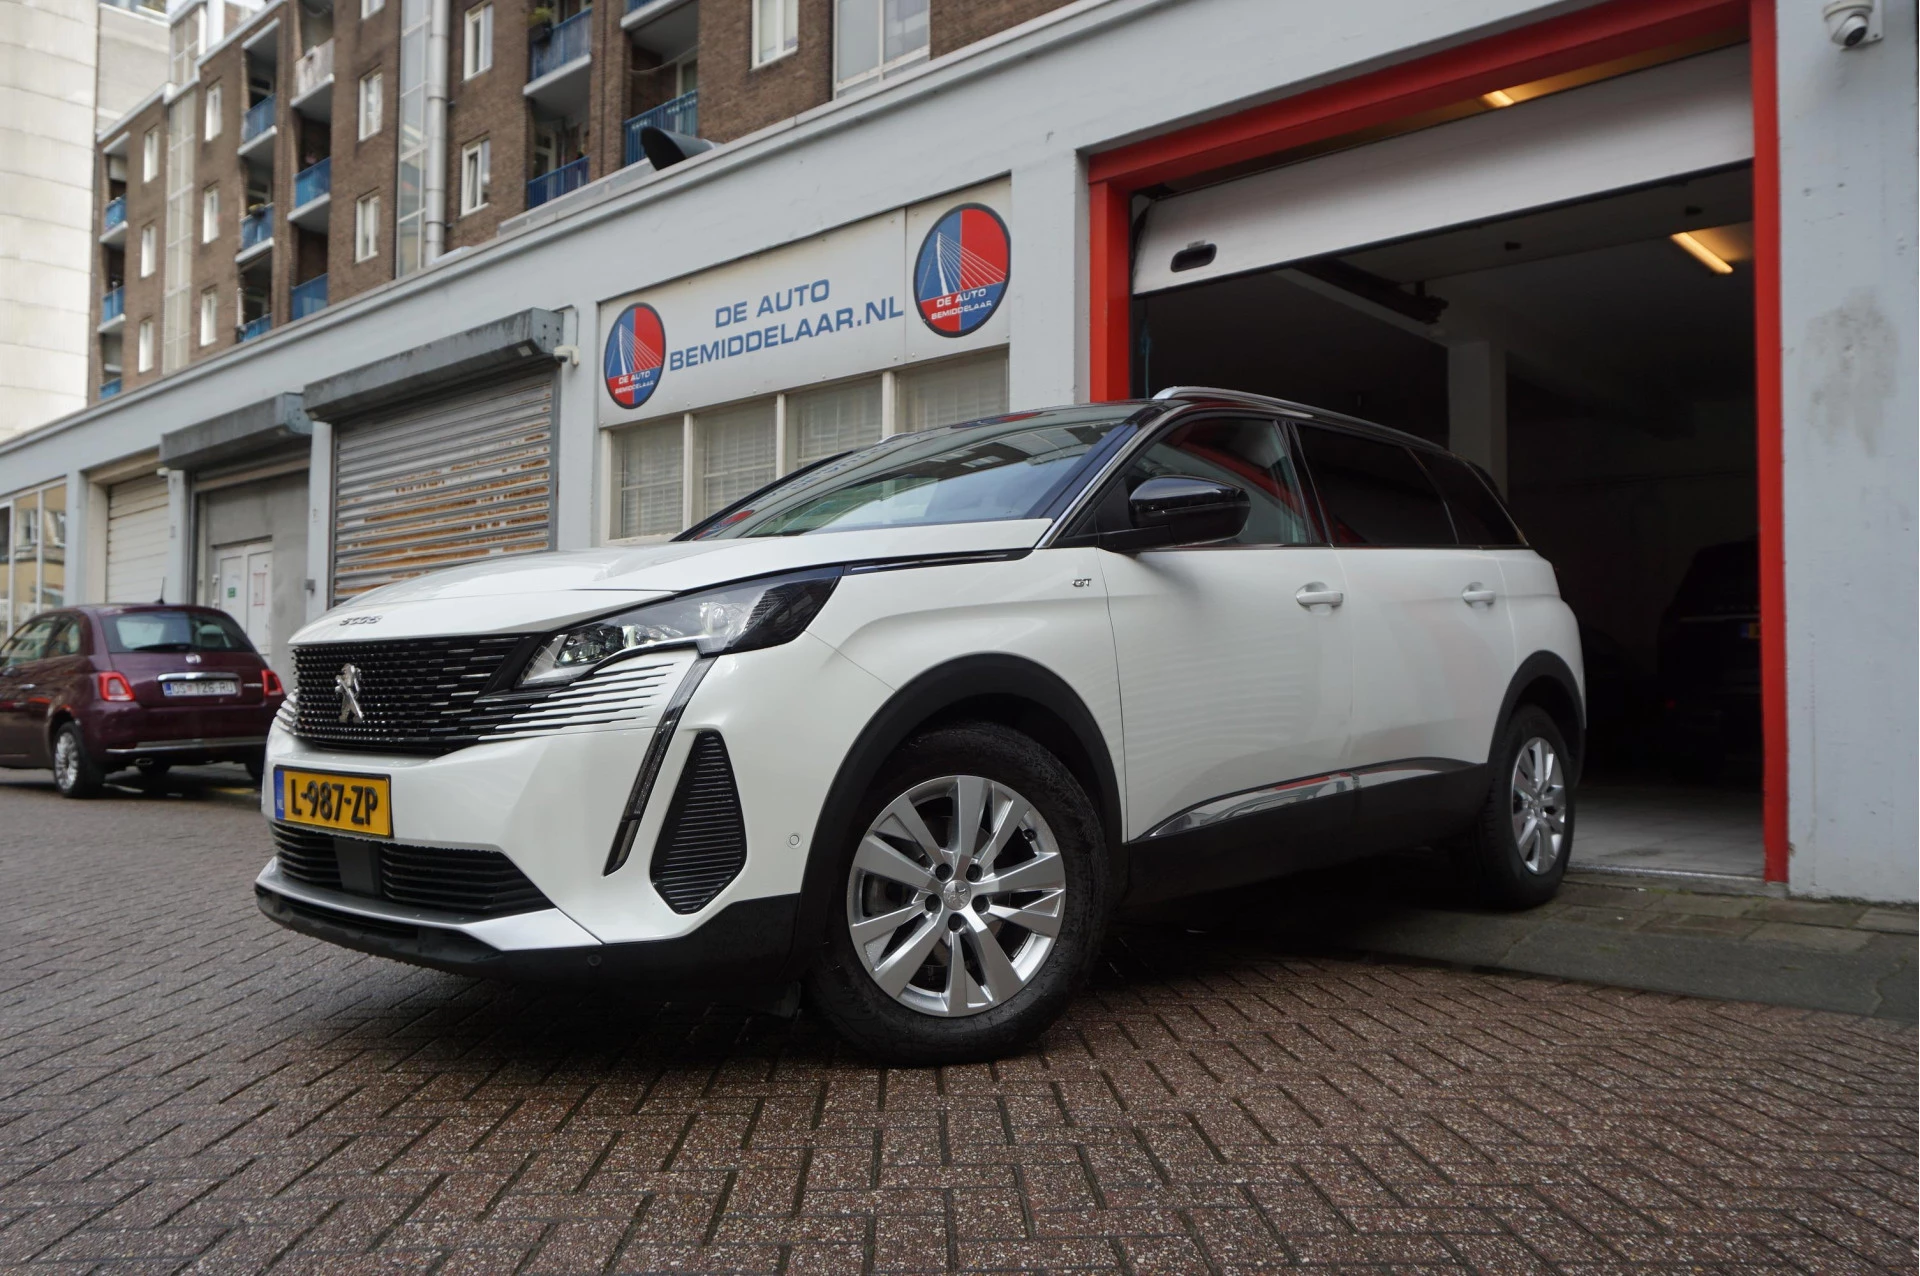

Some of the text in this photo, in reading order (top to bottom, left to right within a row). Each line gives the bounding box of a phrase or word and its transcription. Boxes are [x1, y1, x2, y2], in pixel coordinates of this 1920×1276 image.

[715, 279, 830, 328] DE AUTO
[936, 288, 987, 308] DE AUTO
[931, 300, 992, 320] BEMIDDELAAR
[669, 296, 904, 371] BEMIDDELAAR.NL
[618, 370, 651, 385] DE AUTO
[1072, 578, 1092, 588] GT
[291, 779, 378, 825] L-987-ZP
